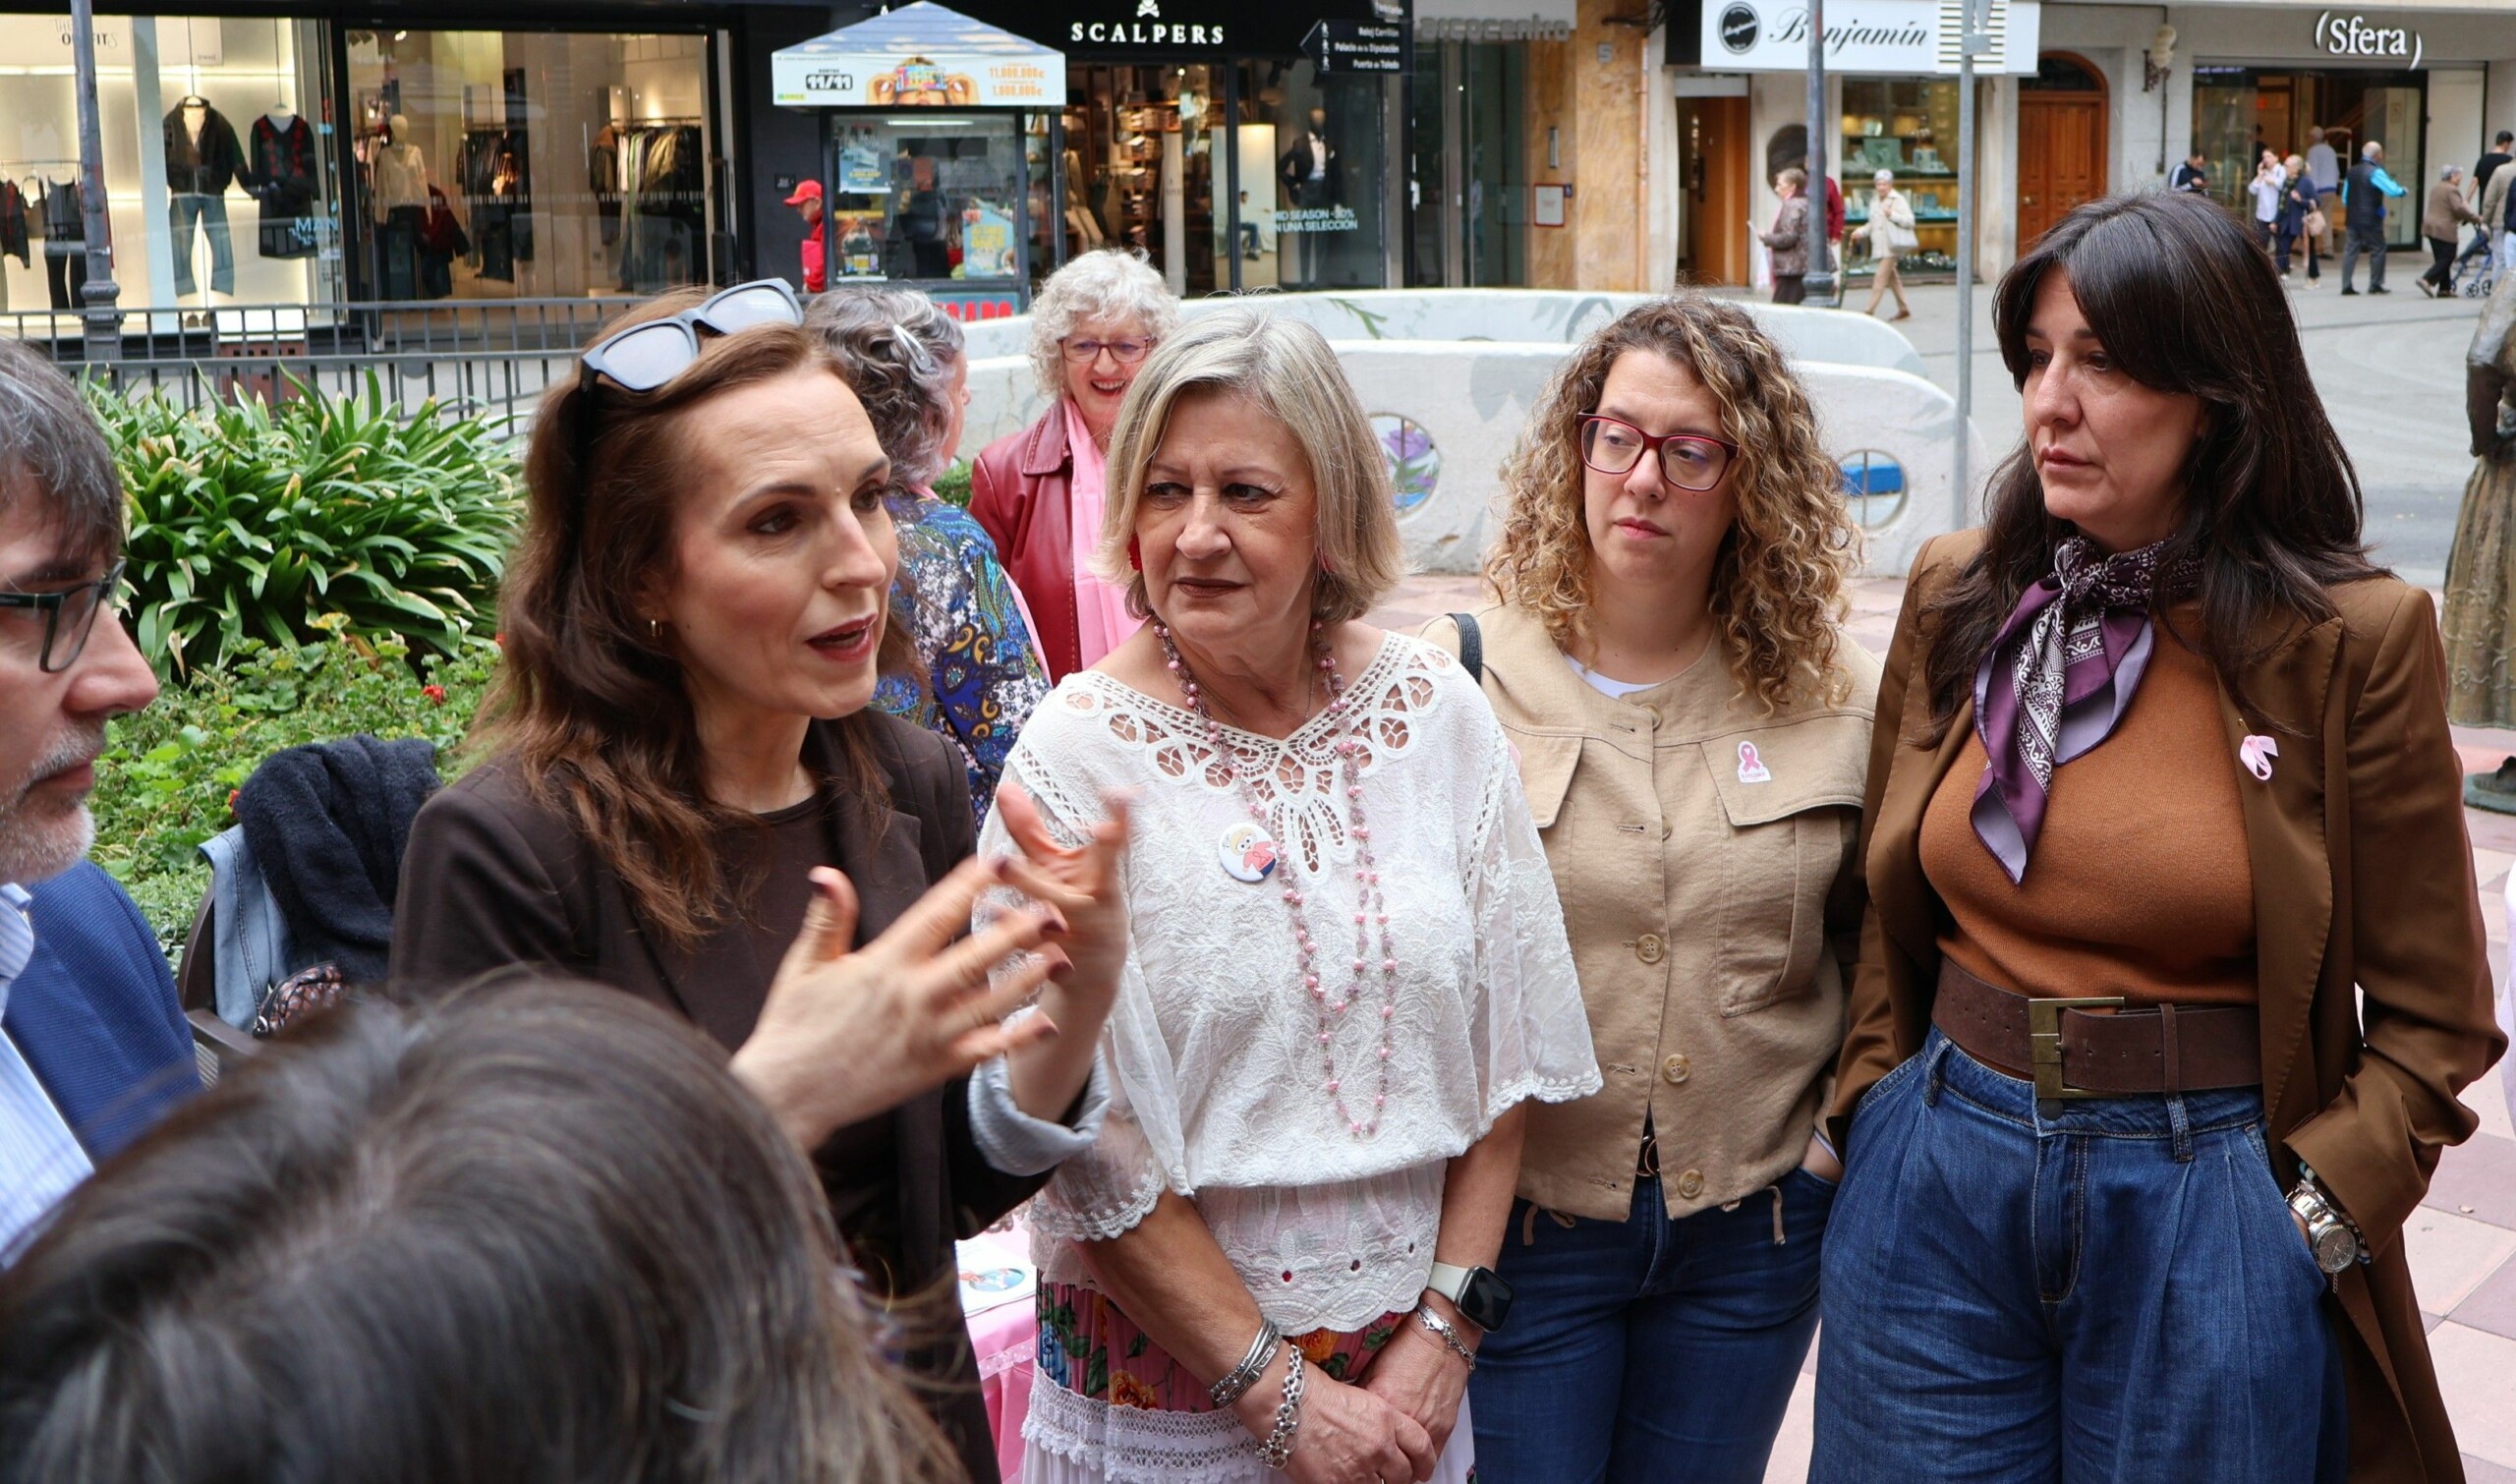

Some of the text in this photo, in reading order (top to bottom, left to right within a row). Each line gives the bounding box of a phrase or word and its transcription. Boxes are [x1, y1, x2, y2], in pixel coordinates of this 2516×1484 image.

[1070, 22, 1224, 45] SCALPERS
[1769, 7, 1928, 56] Bnjamín
[807, 75, 851, 89] 11/11
[1290, 208, 1330, 221] SEASON
[1283, 221, 1304, 233] UNA
